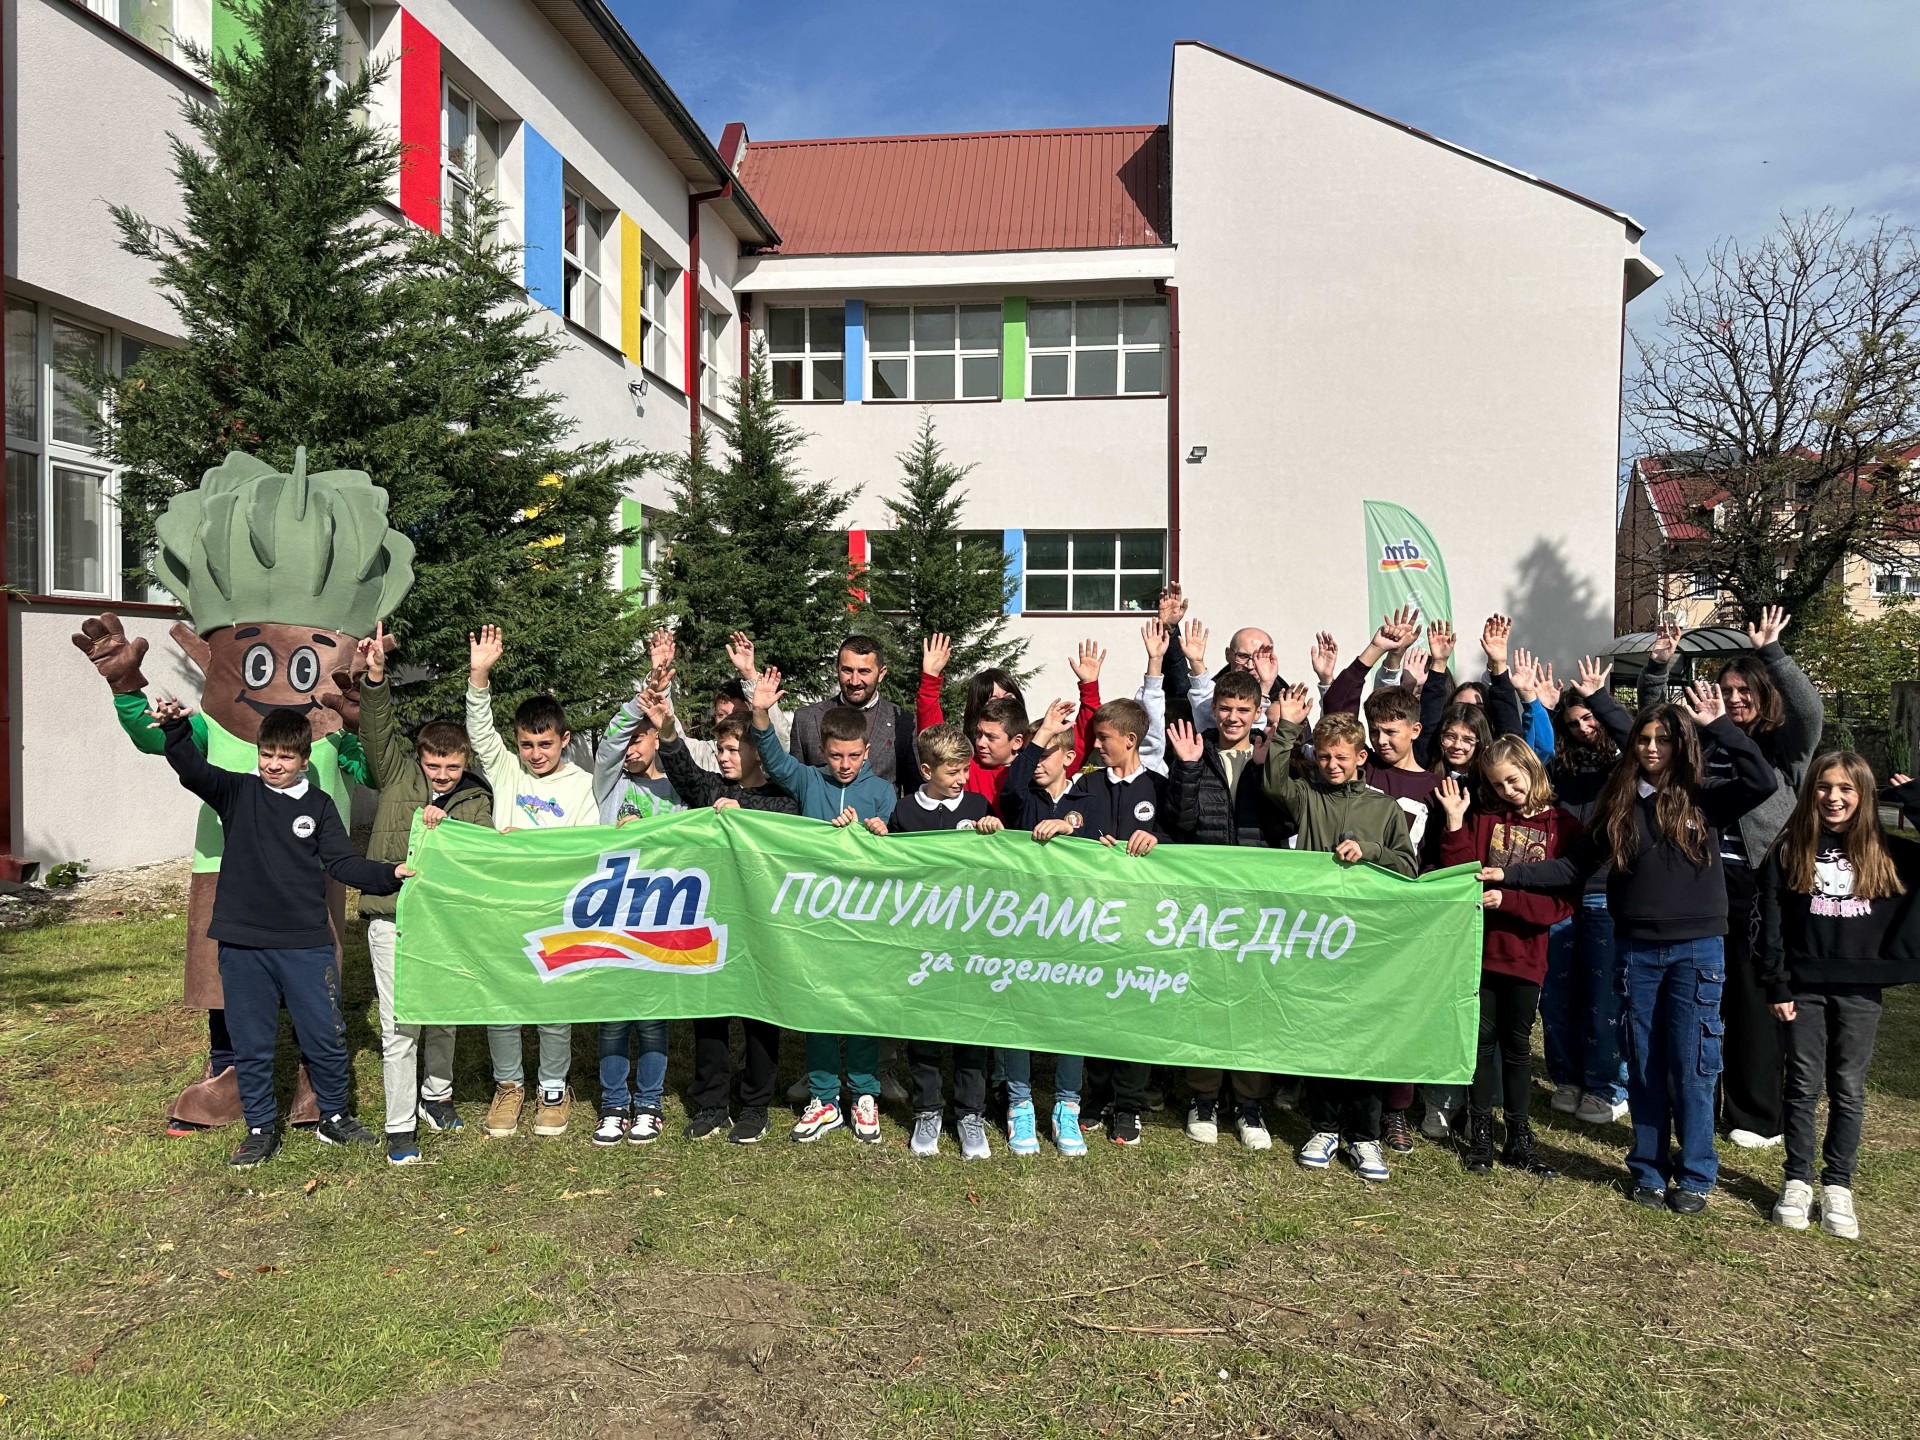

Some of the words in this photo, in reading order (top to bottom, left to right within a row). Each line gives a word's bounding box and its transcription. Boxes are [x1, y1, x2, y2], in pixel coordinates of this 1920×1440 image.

[572, 856, 702, 929] dm
[770, 870, 1129, 945] ПОШУМУВАМЕ
[1145, 898, 1358, 966] ЗАЕДНО
[907, 951, 954, 987] за
[965, 954, 1104, 993] позелено
[1105, 964, 1191, 1004] утре
